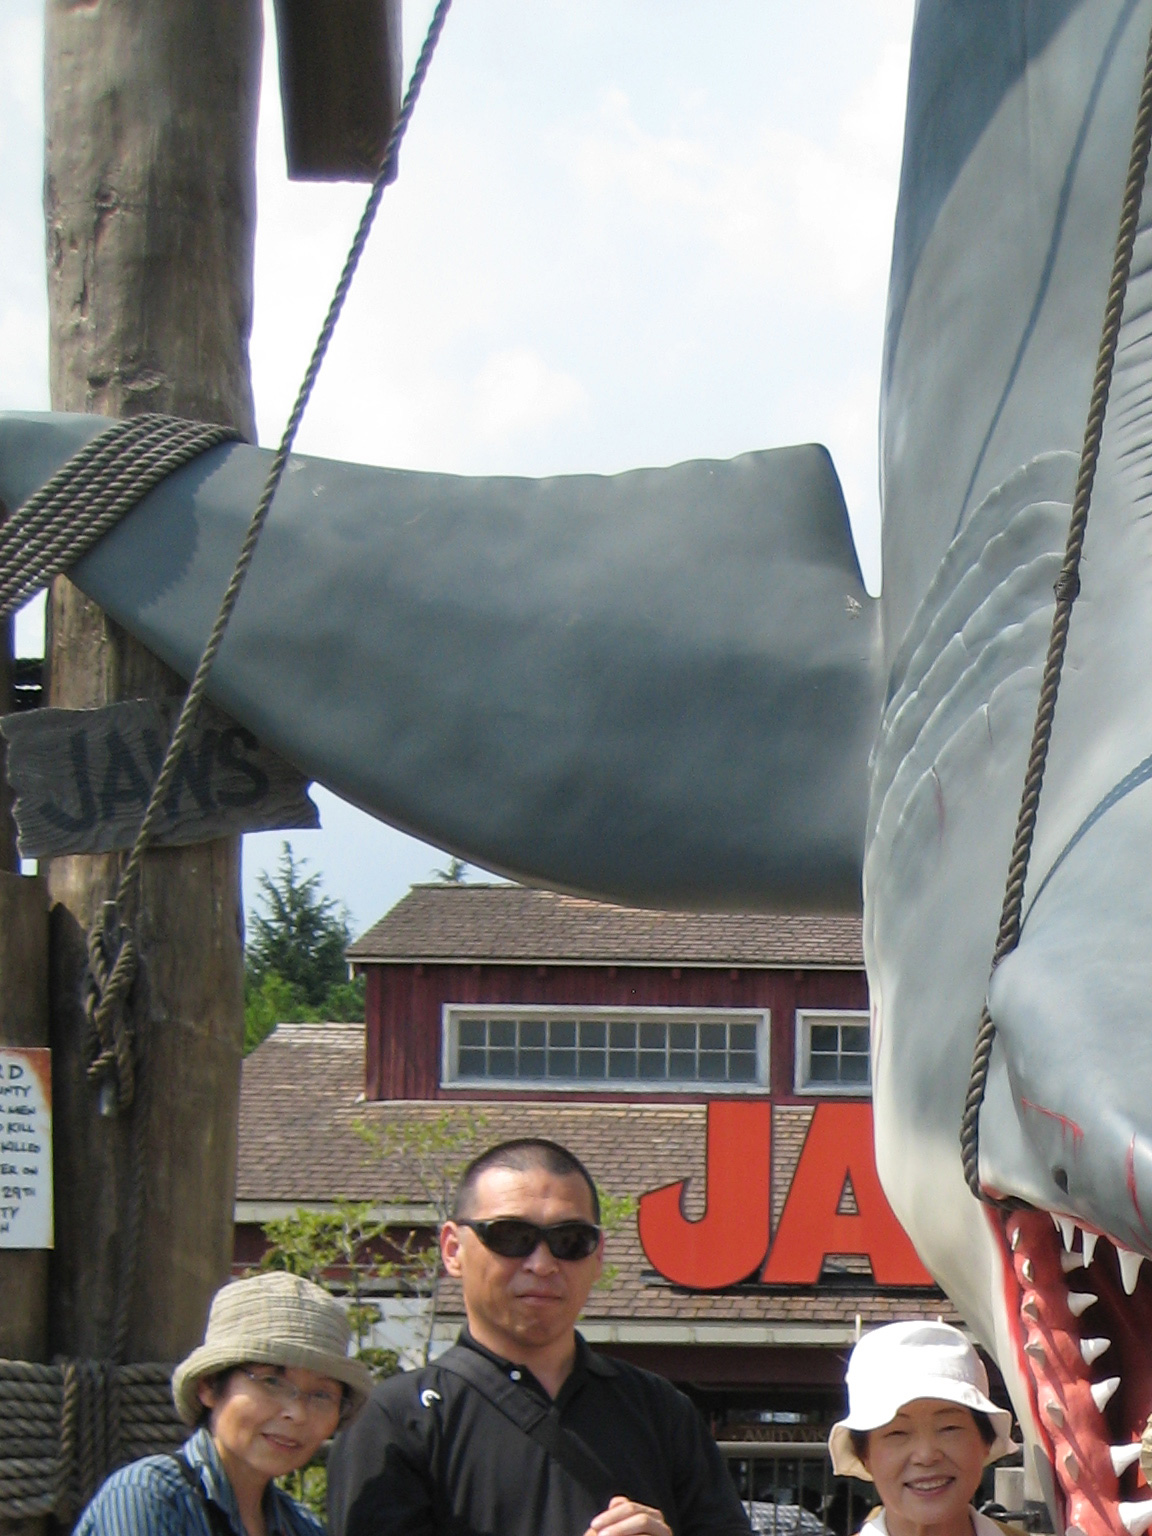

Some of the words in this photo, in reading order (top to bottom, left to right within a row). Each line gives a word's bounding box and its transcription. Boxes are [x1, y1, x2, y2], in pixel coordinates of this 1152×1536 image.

[40, 726, 268, 832] JAWS
[7, 1122, 35, 1134] KILL
[637, 1100, 937, 1290] JA
[744, 1428, 797, 1442] AMITY
